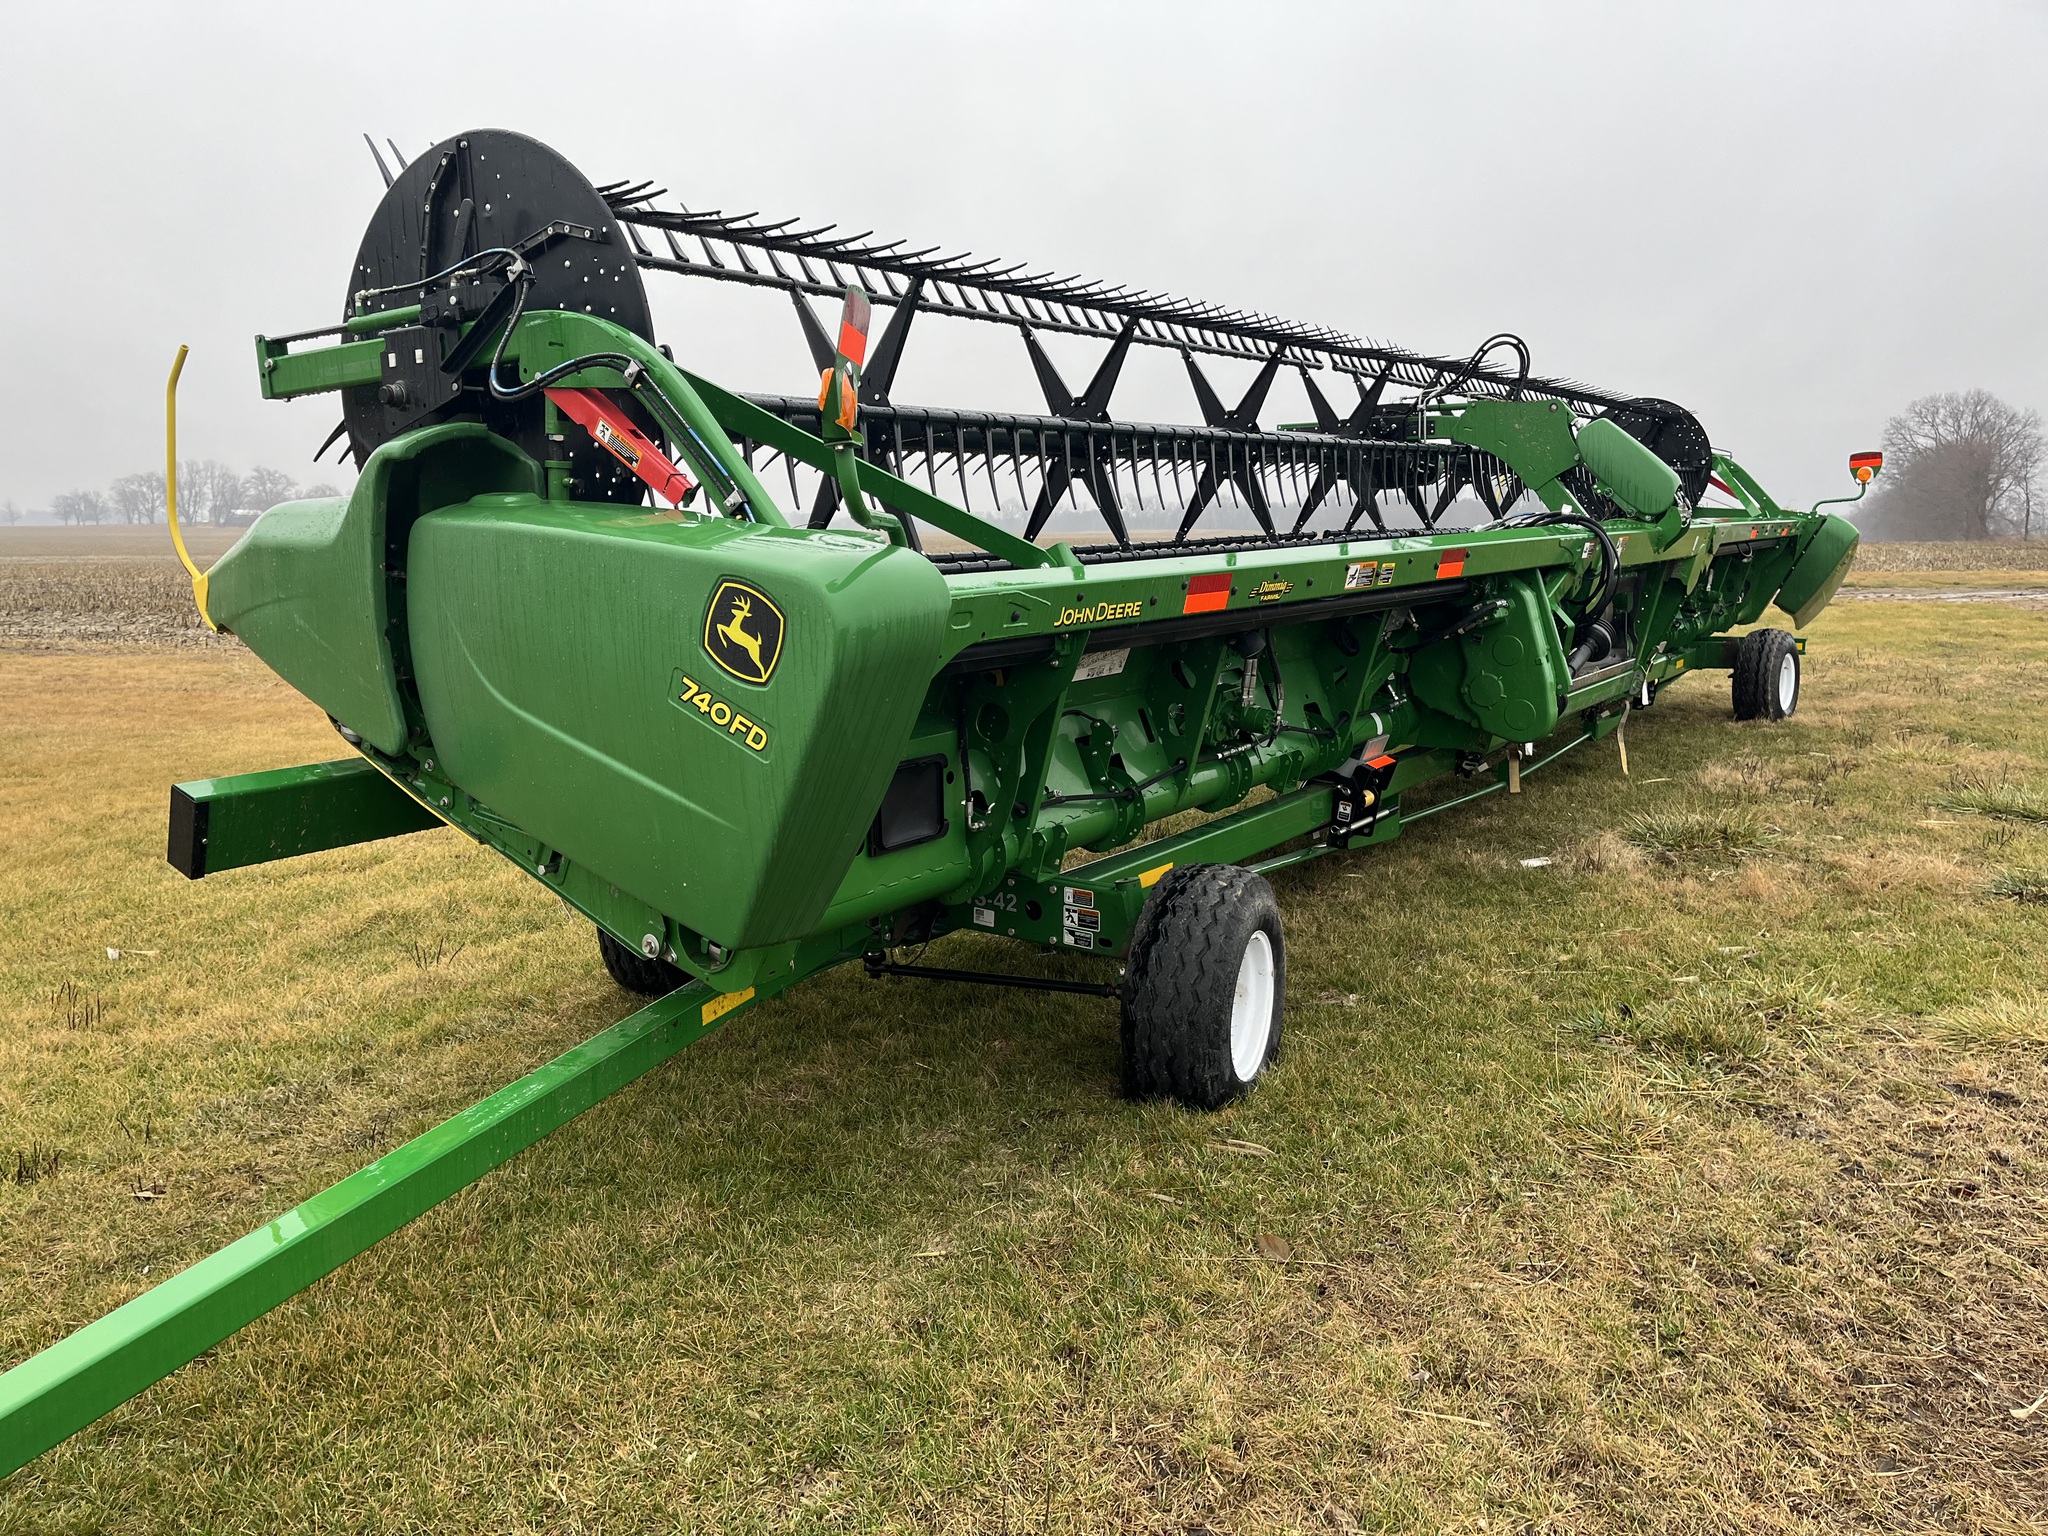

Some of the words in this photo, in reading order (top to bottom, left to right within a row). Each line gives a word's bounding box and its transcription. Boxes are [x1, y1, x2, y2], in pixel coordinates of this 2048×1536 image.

[1053, 606, 1095, 627] JOHN
[1095, 601, 1142, 621] DEERE
[679, 675, 768, 752] 740FD
